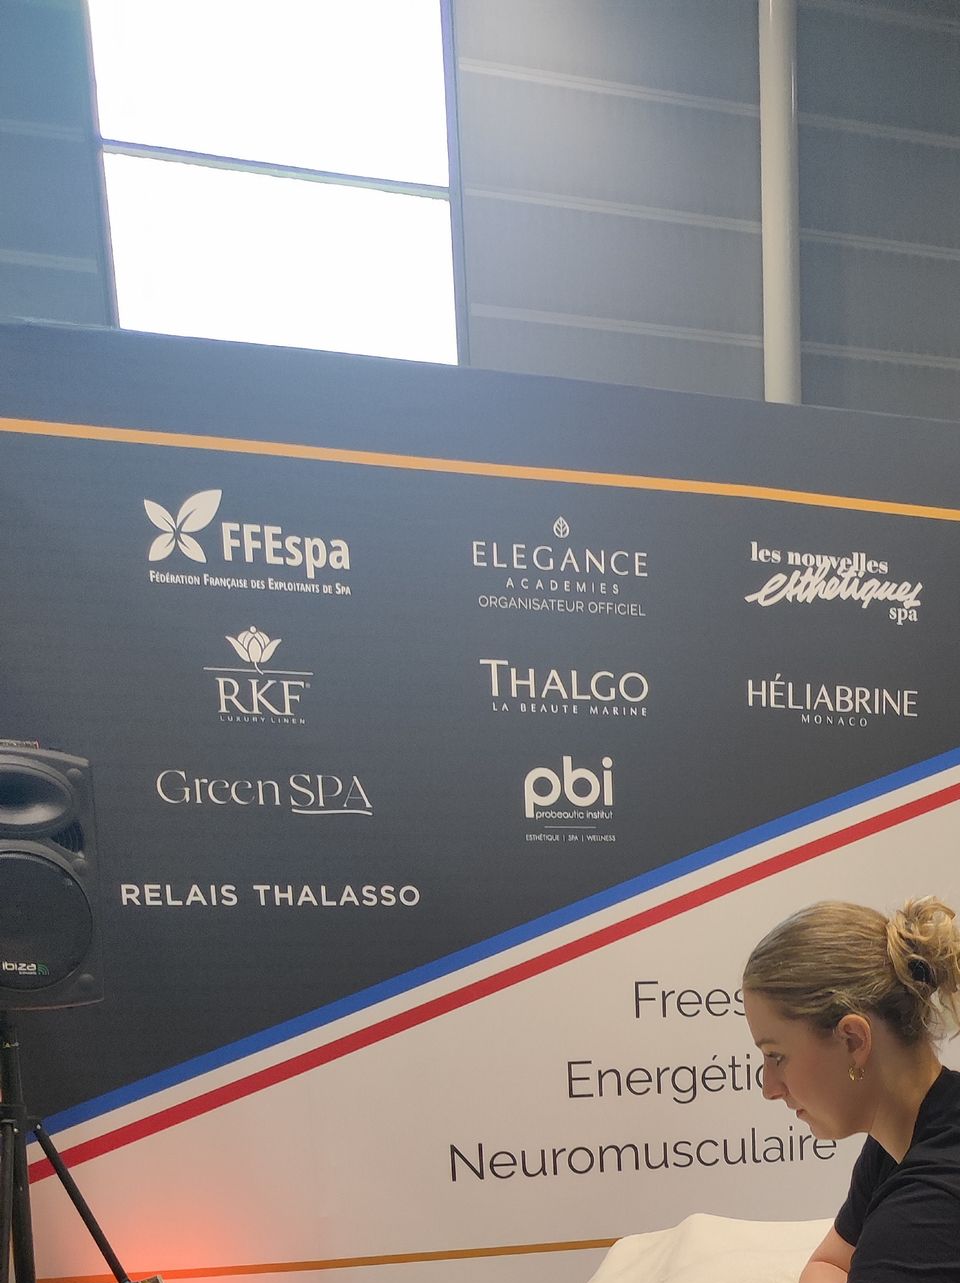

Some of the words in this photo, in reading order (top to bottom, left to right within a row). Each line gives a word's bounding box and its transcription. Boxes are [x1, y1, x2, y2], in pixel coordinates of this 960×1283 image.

[221, 521, 351, 580] FFEspa
[472, 540, 649, 577] ELEGANCE
[751, 541, 782, 563] les
[788, 551, 889, 575] nouvelles
[506, 577, 620, 595] ACADEMIES
[478, 595, 585, 613] ORGANISATEUR
[588, 601, 647, 617] OFFICIEL
[888, 606, 919, 626] spa
[215, 677, 305, 716] RKF
[479, 658, 649, 703] THALGO
[747, 672, 919, 718] HÉLIABRINE
[492, 701, 510, 713] LA
[520, 703, 579, 715] BEAUTE
[589, 705, 648, 717] MARINE
[801, 713, 868, 728] MONACO
[156, 769, 282, 806] Green
[289, 773, 374, 809] SPA
[524, 755, 613, 818] pbi
[120, 884, 239, 907] RELAIS
[253, 884, 421, 907] THALASSO
[449, 1125, 837, 1183] Neuromusculaire
